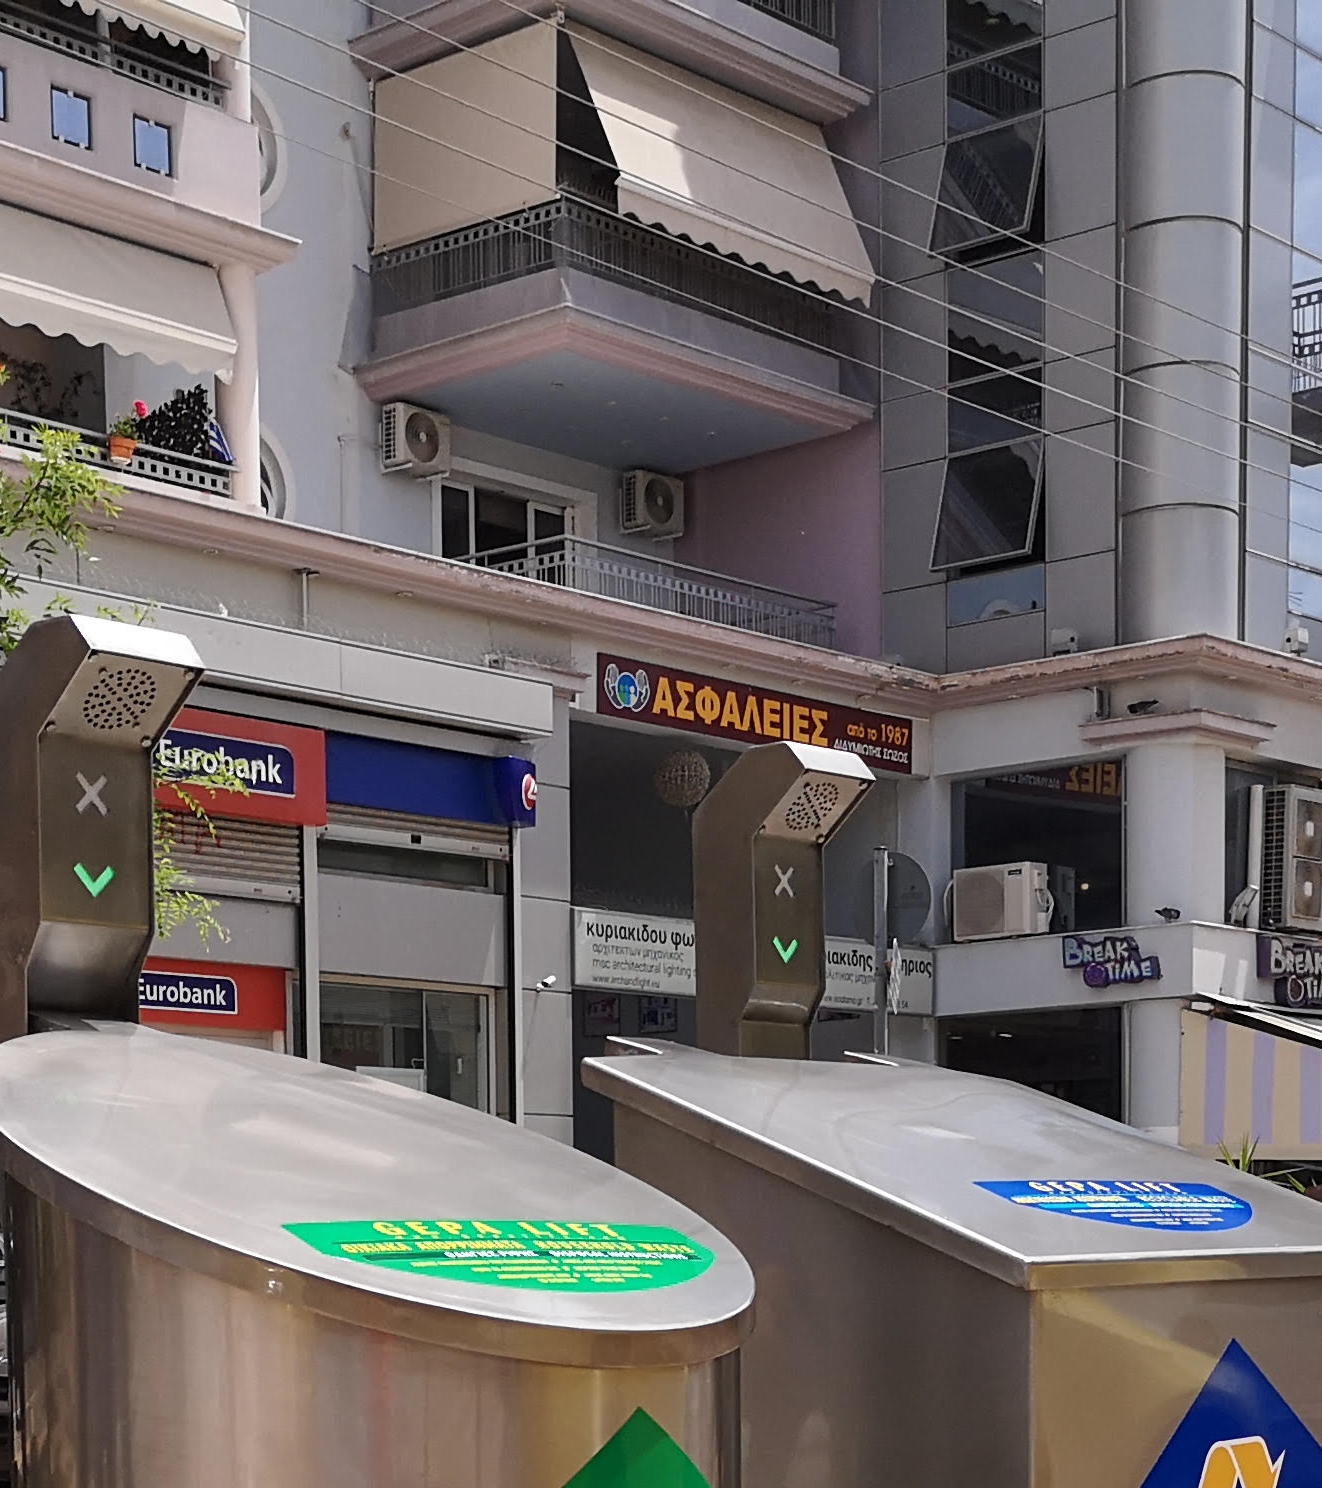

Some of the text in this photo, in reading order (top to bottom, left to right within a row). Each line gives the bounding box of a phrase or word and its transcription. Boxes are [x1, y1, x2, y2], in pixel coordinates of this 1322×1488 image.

[651, 676, 828, 747] ΑΣΦΑΛΕΙΕΣ
[846, 722, 909, 746] από το 1987
[159, 738, 283, 785] Eurobank
[833, 737, 909, 764] ΔΙΔΥΜΙΩΤΗΣ ΣΩΖΟΣ
[586, 922, 667, 945] κυριακιδου
[1065, 937, 1130, 965] BREAK
[612, 960, 661, 974] architectural
[663, 963, 692, 979] lighting
[138, 978, 227, 1006] Eurobank
[1114, 1182, 1182, 1193] LIFT
[372, 1220, 502, 1236] GEPA
[517, 1221, 620, 1238] LIFT
